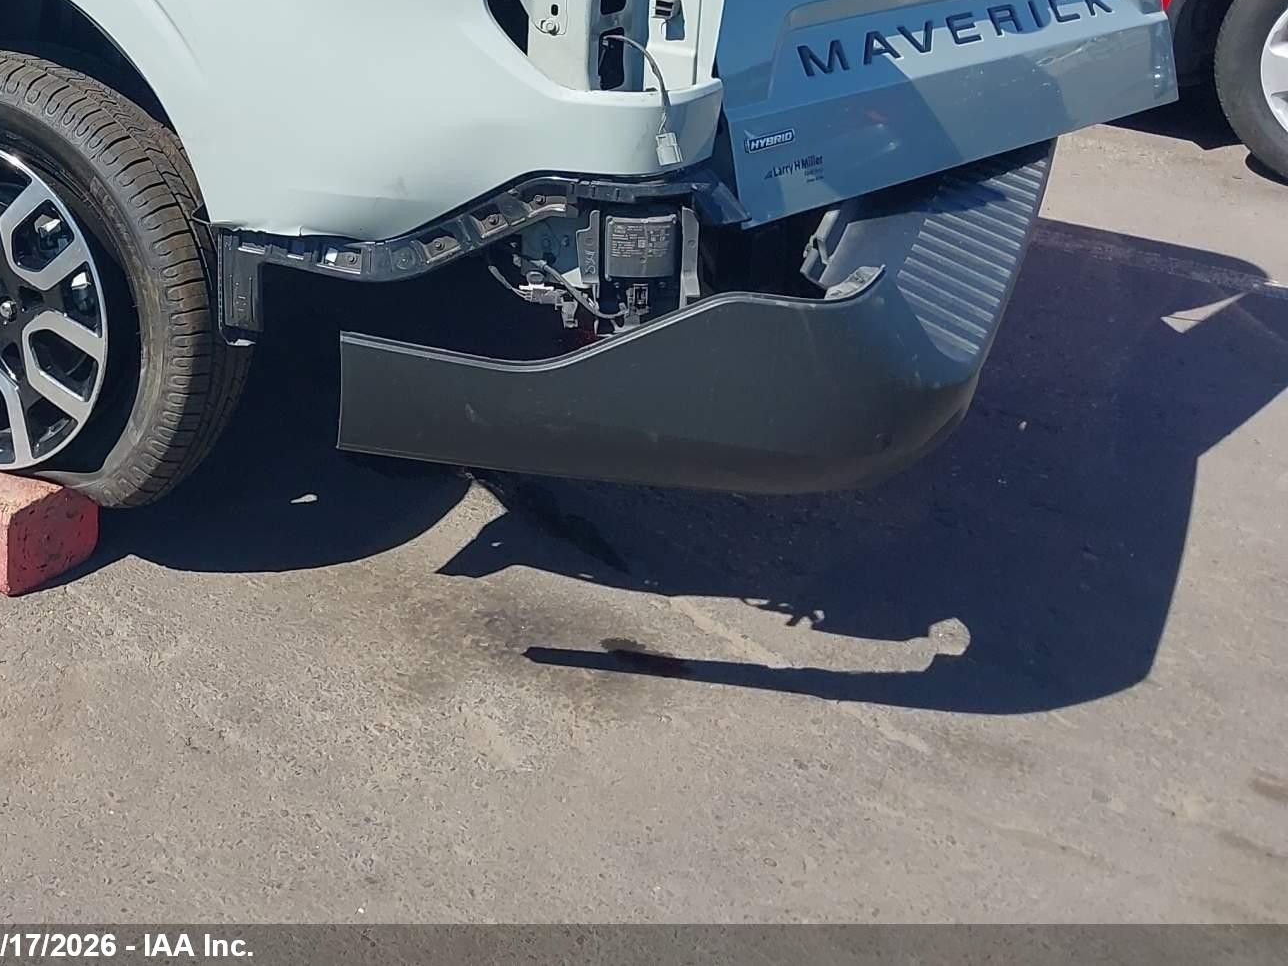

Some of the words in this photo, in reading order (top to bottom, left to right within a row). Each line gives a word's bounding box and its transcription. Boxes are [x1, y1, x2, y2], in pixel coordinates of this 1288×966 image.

[750, 132, 792, 150] HYBRID
[773, 165, 793, 177] Larry
[794, 161, 801, 171] H
